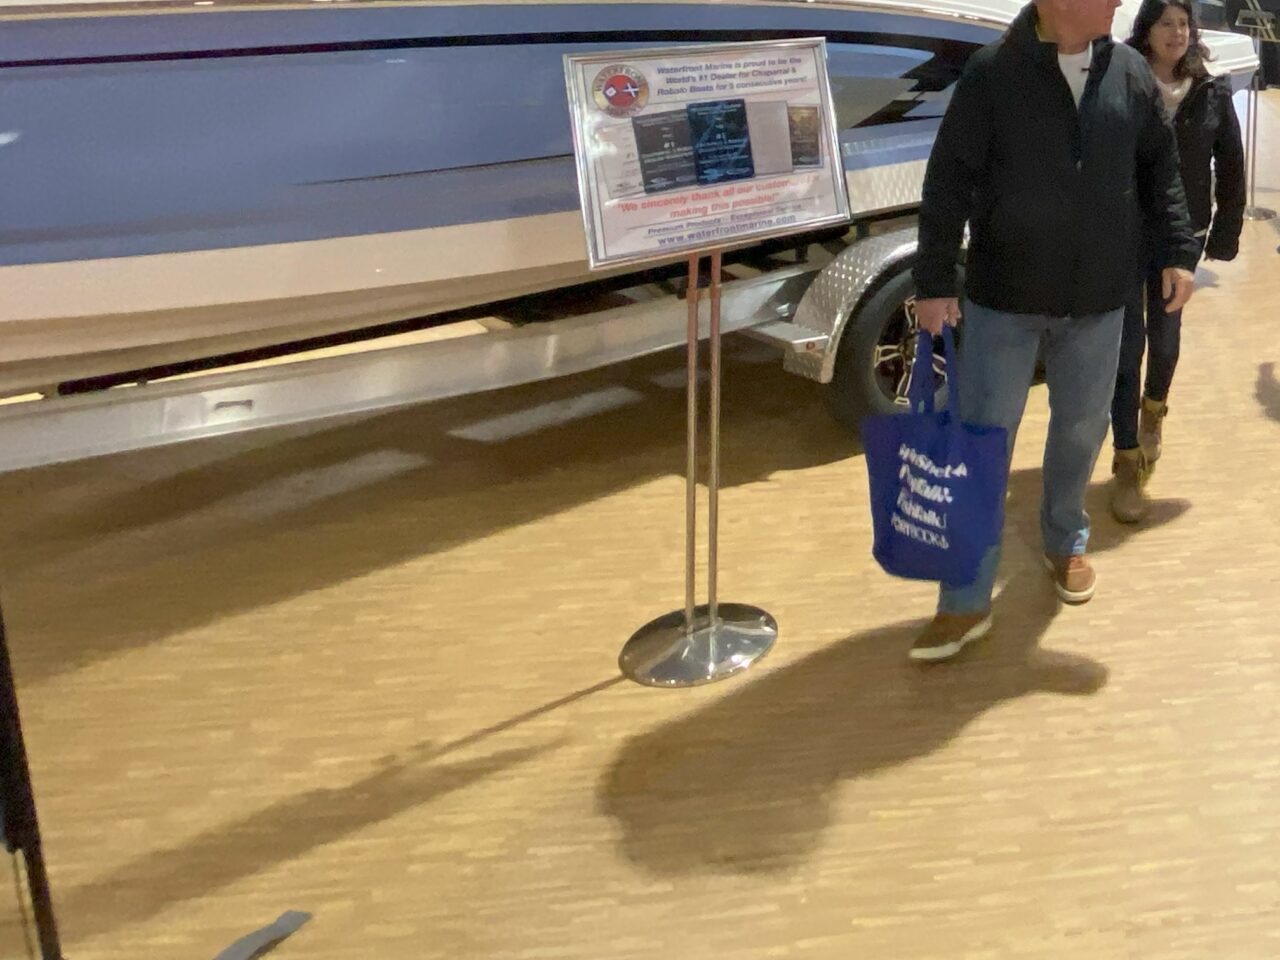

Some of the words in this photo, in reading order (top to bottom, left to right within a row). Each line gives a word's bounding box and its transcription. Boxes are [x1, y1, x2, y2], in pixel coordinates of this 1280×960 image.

[657, 64, 702, 75] Waterfront
[705, 62, 733, 71] Marine
[735, 61, 741, 69] is
[744, 59, 766, 70] proud
[666, 75, 696, 84] World's
[699, 74, 707, 82] #1
[710, 72, 737, 81] Dealer
[738, 71, 750, 79] for
[752, 68, 789, 79] Chaparral
[657, 87, 687, 96] Robalo
[689, 85, 714, 93] Boats
[736, 78, 782, 89] consecutive
[641, 196, 688, 211] sincerely
[691, 191, 720, 202] thank
[722, 187, 735, 196] all
[738, 185, 753, 195] our
[669, 205, 708, 218] making
[711, 201, 730, 212] this
[647, 223, 684, 235] Premium
[686, 217, 721, 230] Products
[658, 214, 796, 246] www.waterfrontmarine.com
